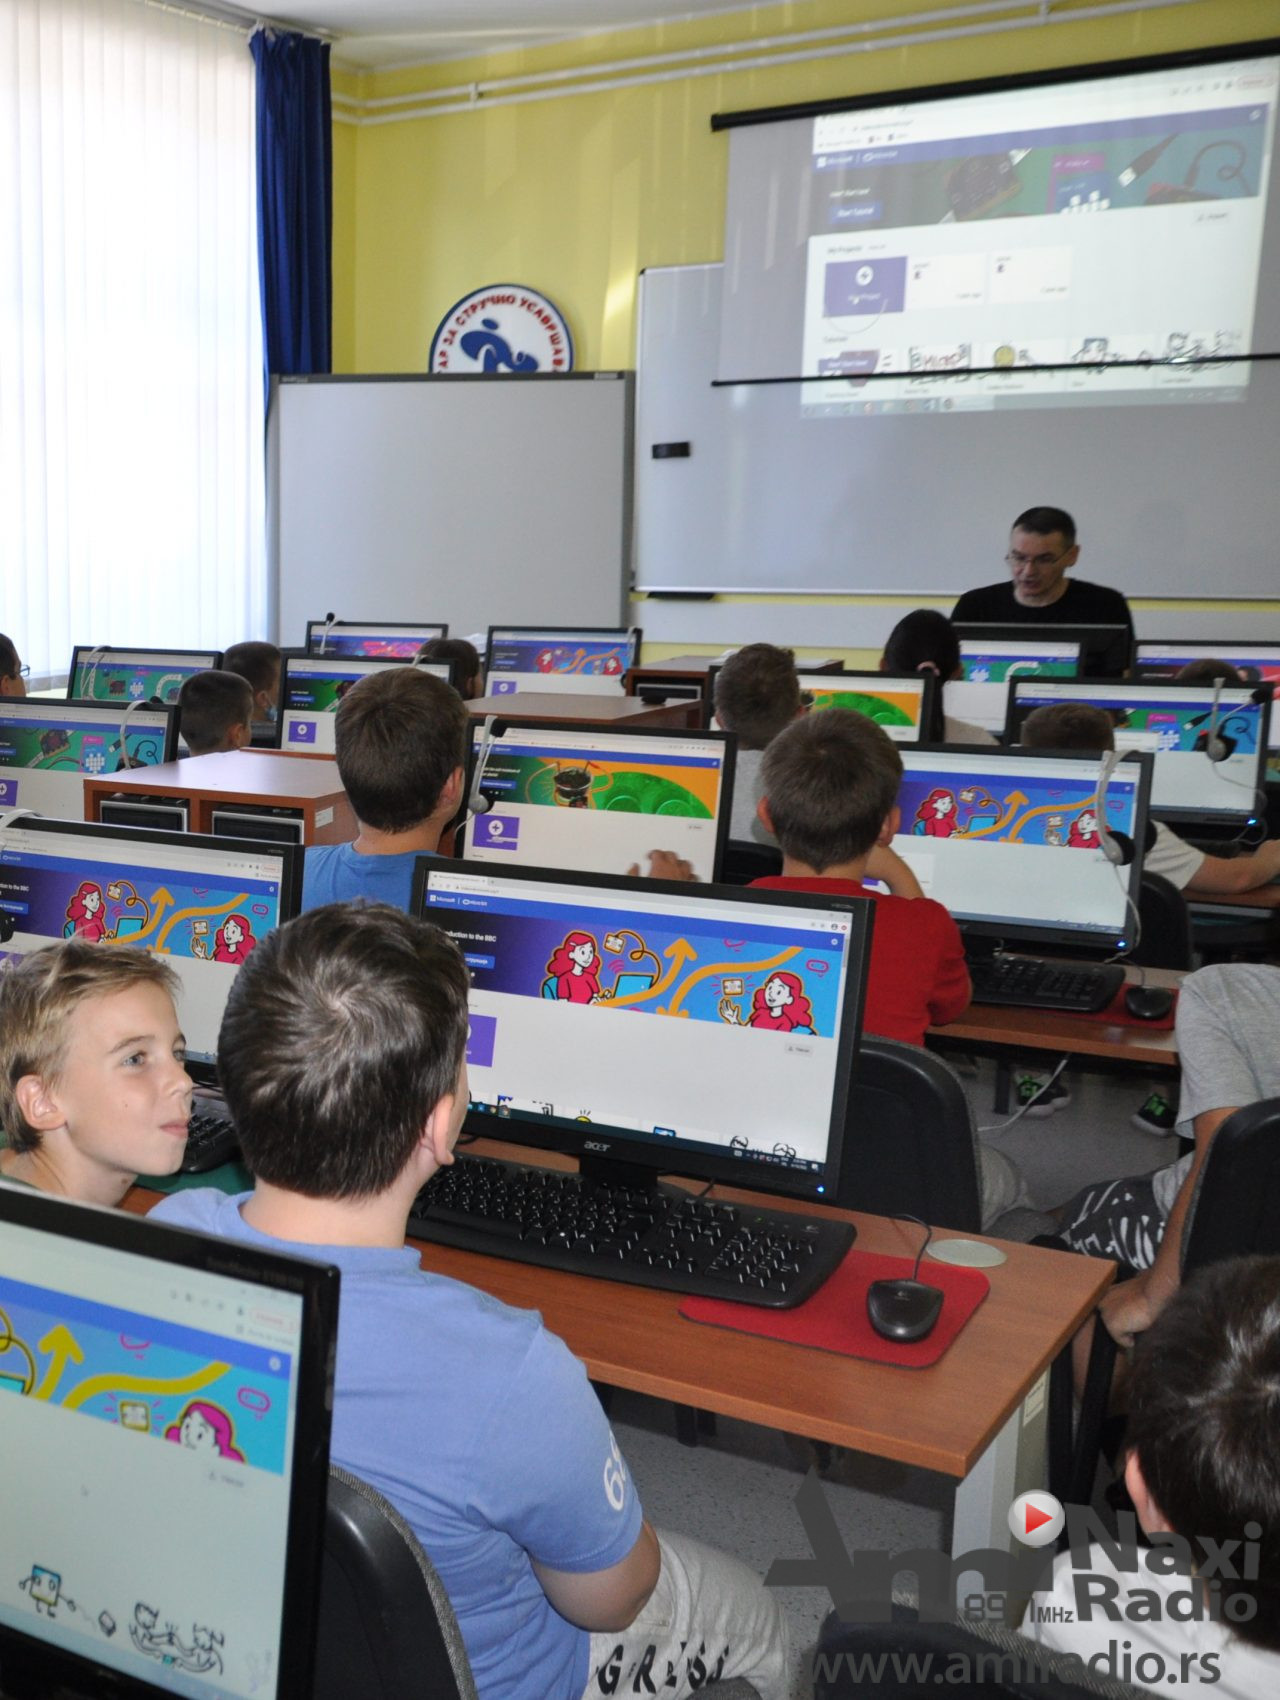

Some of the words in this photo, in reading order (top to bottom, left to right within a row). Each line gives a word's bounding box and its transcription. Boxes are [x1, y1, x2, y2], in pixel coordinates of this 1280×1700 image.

[443, 328, 458, 346] ЗА
[455, 295, 516, 326] СТРУЧНО
[519, 297, 565, 373] УСАВРШАВ
[583, 1141, 611, 1152] acer
